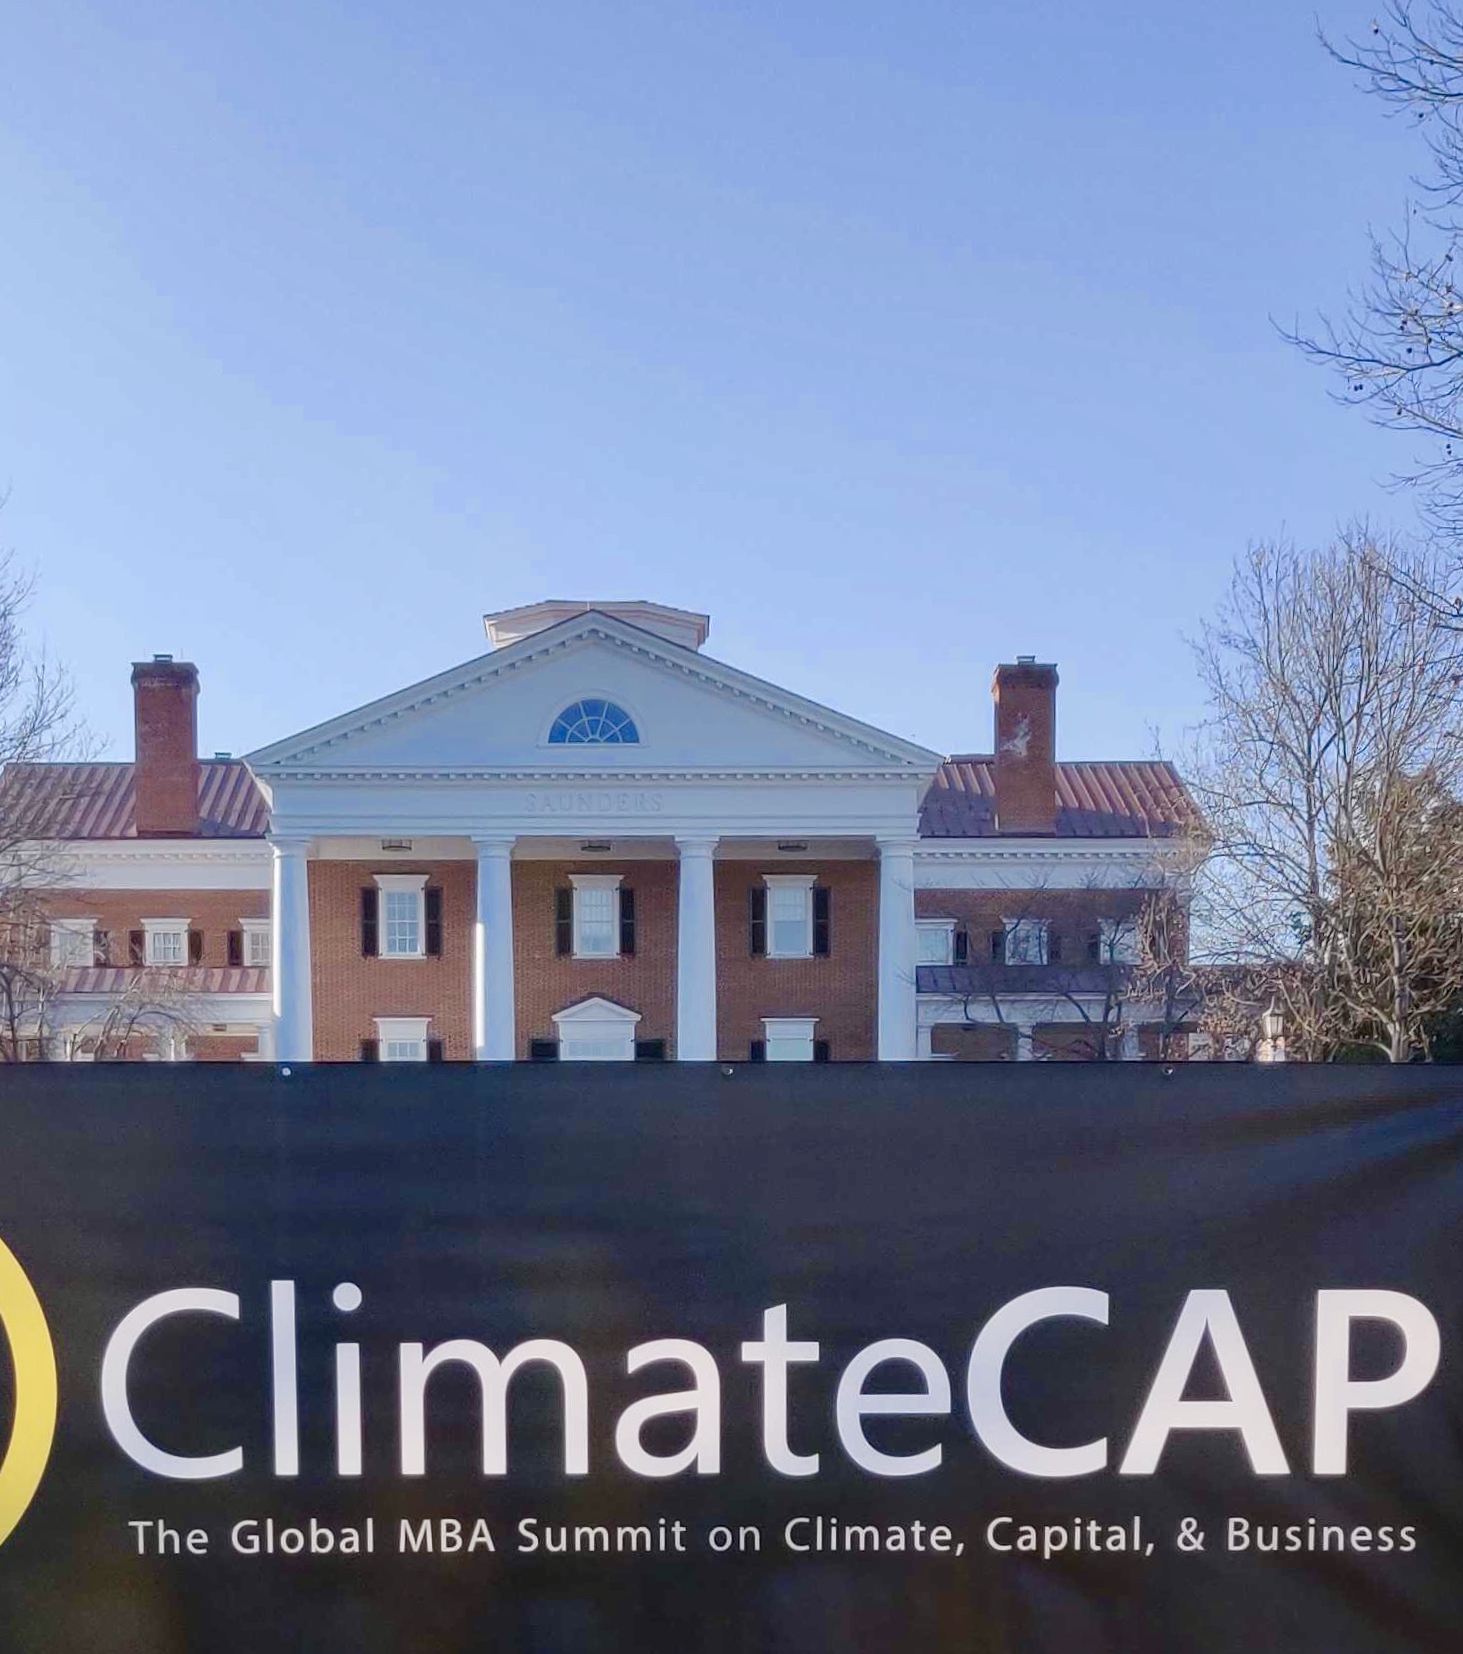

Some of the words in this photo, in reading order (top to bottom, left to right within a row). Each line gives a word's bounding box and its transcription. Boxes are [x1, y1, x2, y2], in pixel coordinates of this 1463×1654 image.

[524, 792, 664, 813] SAUNDERS
[99, 1278, 1441, 1481] ClimateCAP
[128, 1519, 209, 1555] The
[230, 1517, 375, 1555] Global
[398, 1518, 496, 1554] MBA
[518, 1518, 688, 1553] Summit
[708, 1526, 761, 1553] on
[784, 1516, 965, 1558] Climate,
[986, 1515, 1155, 1560] Capital,
[1176, 1517, 1206, 1553] &
[1226, 1517, 1417, 1553] Business
